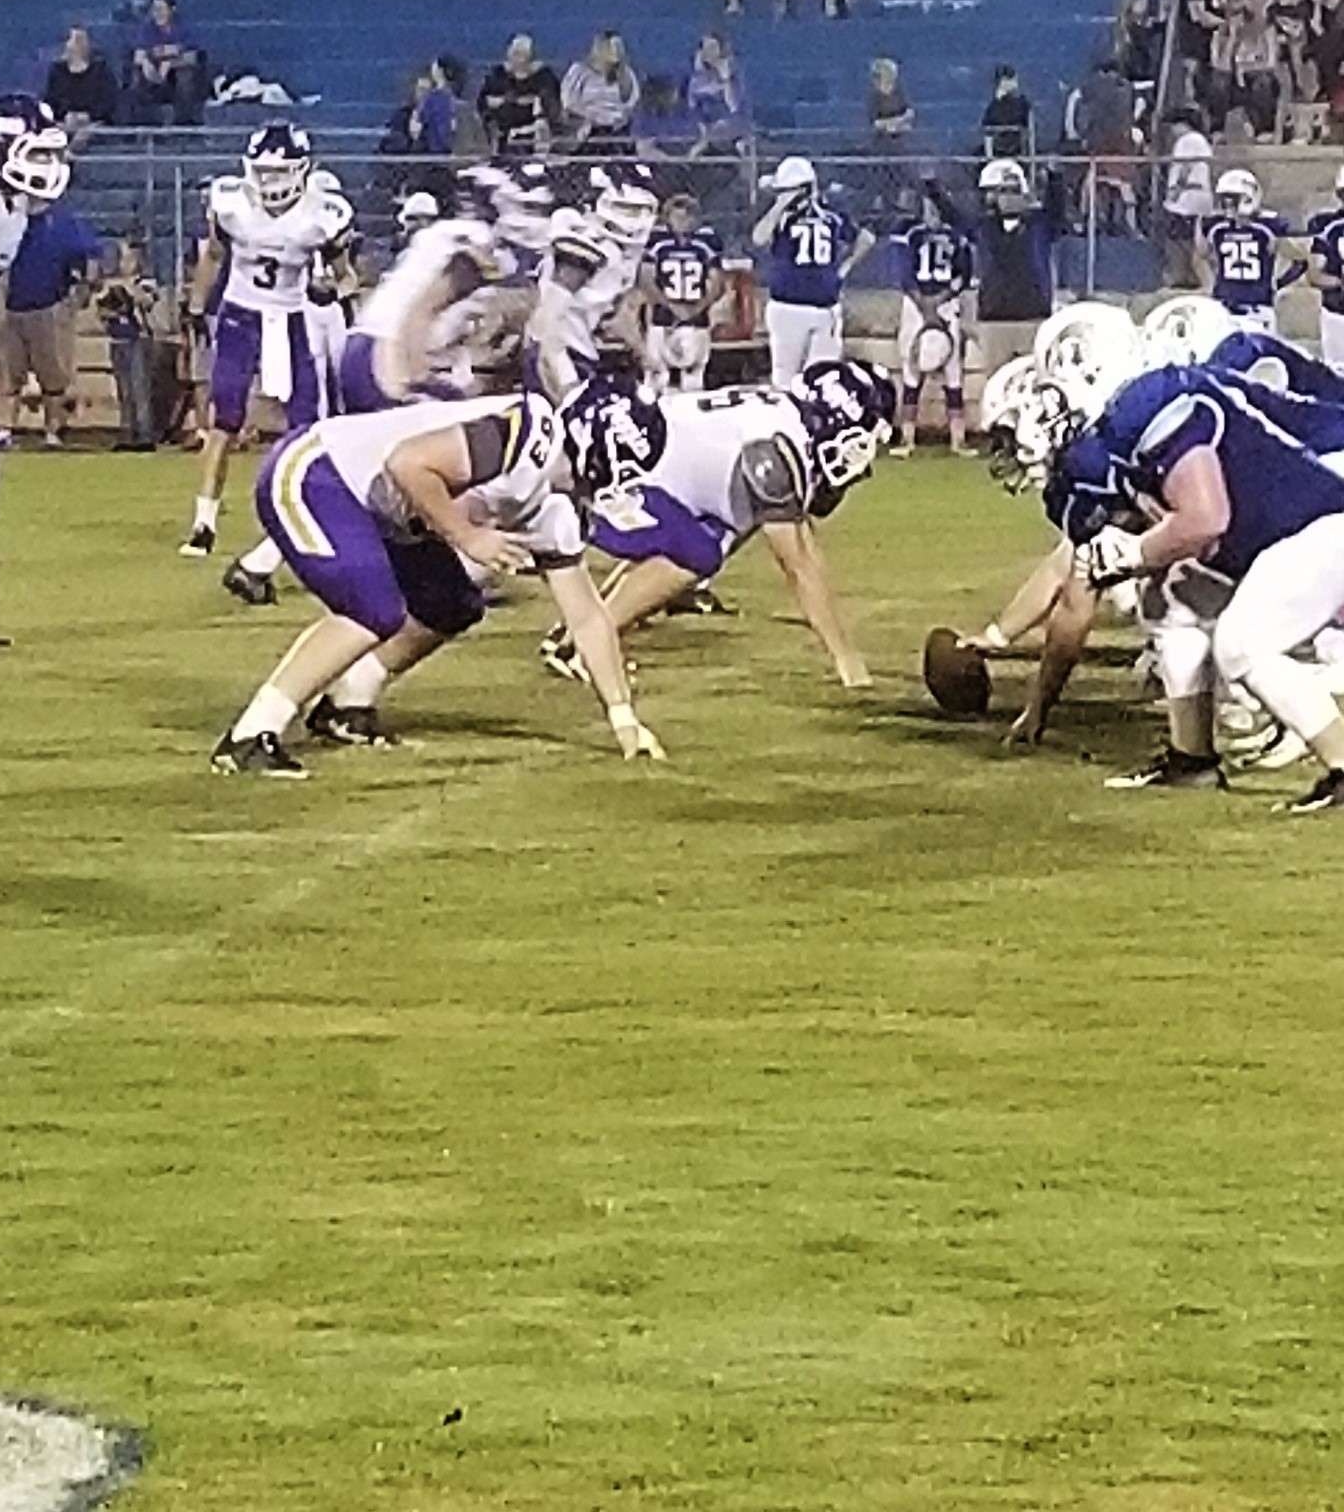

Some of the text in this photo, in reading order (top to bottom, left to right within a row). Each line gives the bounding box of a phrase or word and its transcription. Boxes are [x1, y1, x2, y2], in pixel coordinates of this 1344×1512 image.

[791, 225, 832, 265] 76
[1220, 240, 1261, 281] 25
[253, 254, 279, 290] 3
[661, 260, 704, 300] 32
